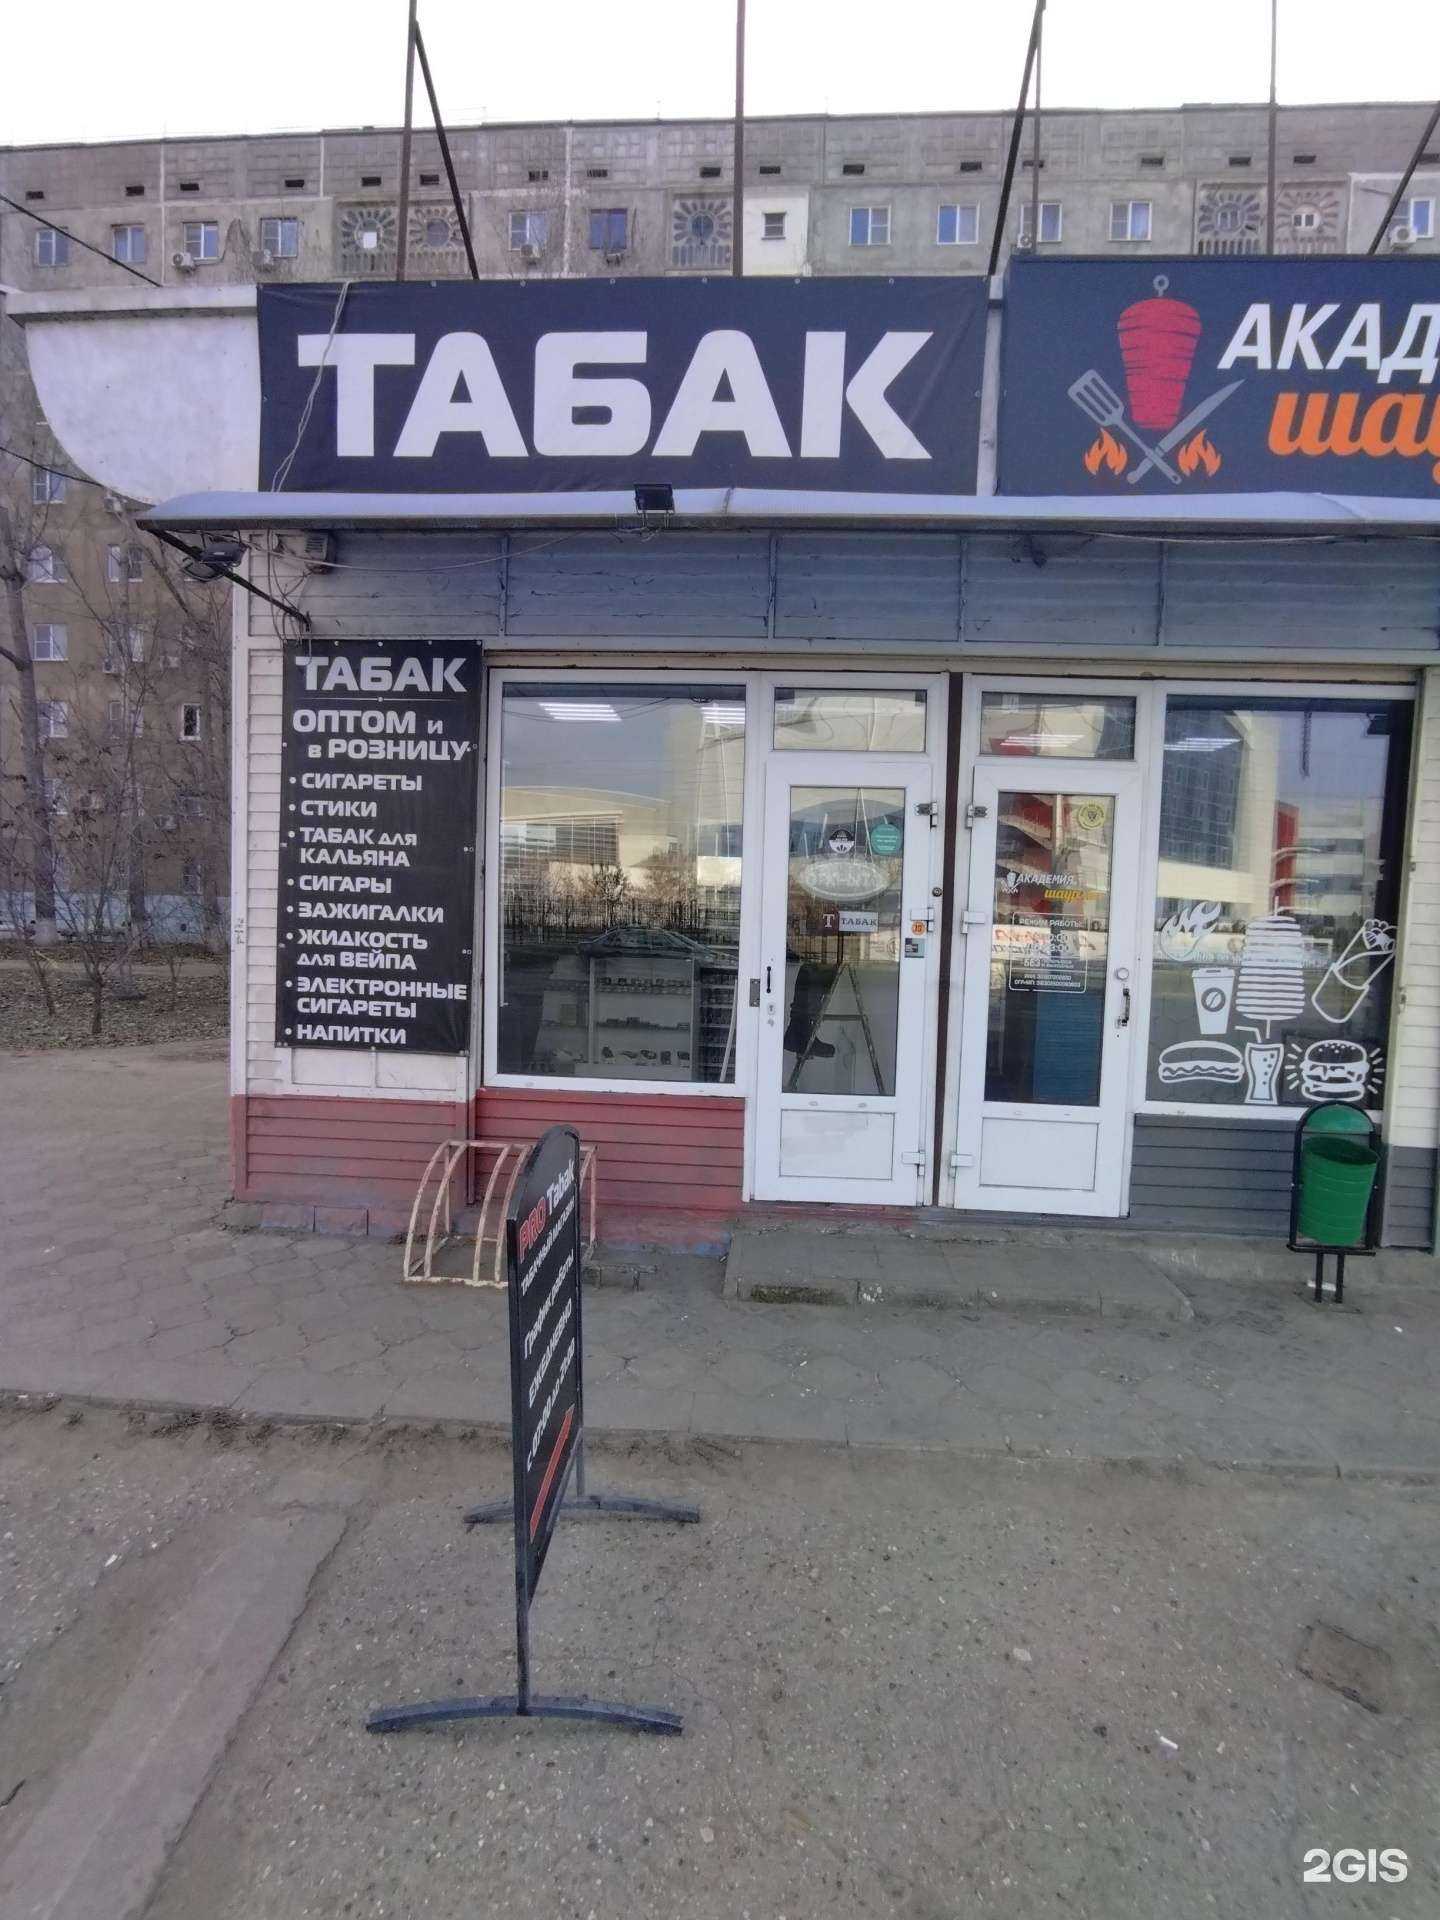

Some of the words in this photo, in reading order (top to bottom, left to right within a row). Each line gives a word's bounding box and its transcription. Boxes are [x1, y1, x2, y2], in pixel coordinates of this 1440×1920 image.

[1217, 303, 1440, 384] АКАД
[297, 329, 934, 460] ТАБАК
[1268, 392, 1440, 485] ша
[295, 656, 467, 692] ТАБАК
[292, 709, 417, 734] ОПТОМ
[427, 719, 443, 734] и
[308, 745, 322, 758] в
[328, 739, 470, 761] РОЗНИЦУ
[301, 772, 423, 791] СИГАРЕТЫ
[300, 800, 377, 817] СТИКИ
[300, 827, 375, 844] ТАБАК
[378, 832, 417, 846] для
[300, 848, 411, 867] КАЛЬЯНА
[299, 874, 392, 894] СИГАРЫ
[1016, 873, 1074, 885] АКАДЕМИЯ
[298, 901, 444, 923] ЗАЖИГАЛКИ
[841, 917, 878, 926] ТАБАК
[297, 929, 428, 950] ЖИДКОСТЬ
[296, 953, 335, 966] для
[339, 949, 417, 970] ВЕЙПА
[297, 976, 468, 1000] ЭЛЕКТРОННЫЕ
[297, 998, 417, 1018] СИГАРЕТЫ
[296, 1024, 407, 1045] НАПИТКИ
[519, 1197, 547, 1264] PRO
[546, 1158, 575, 1215] Tabak
[521, 1229, 552, 1297] ТАБАЧНЫЙ
[524, 1293, 551, 1359] График
[529, 1297, 572, 1408] ЕЖЕДНЕВНО
